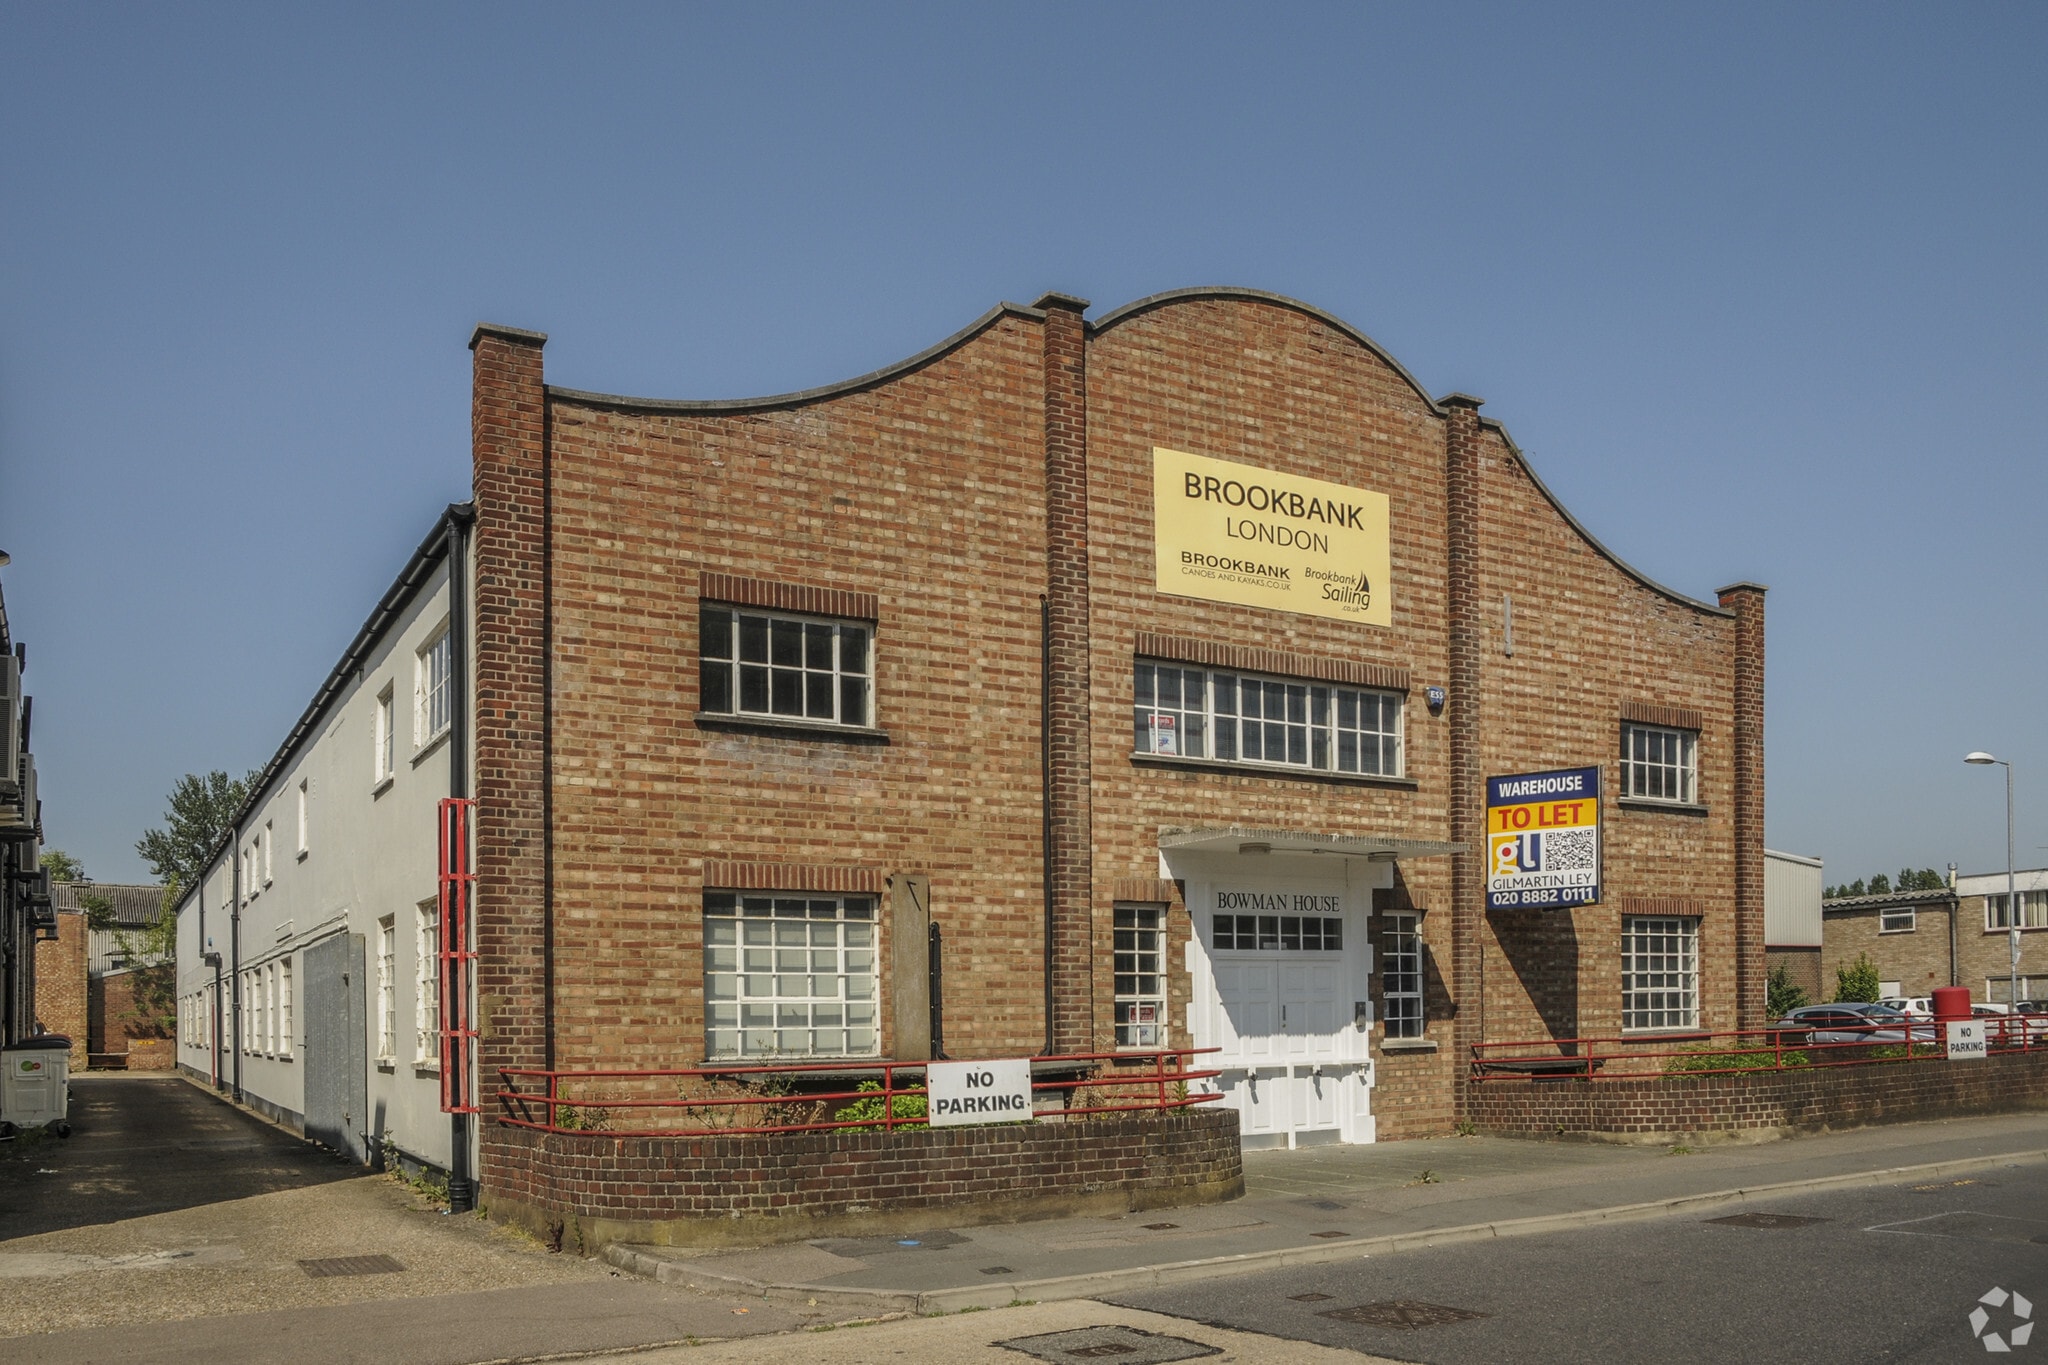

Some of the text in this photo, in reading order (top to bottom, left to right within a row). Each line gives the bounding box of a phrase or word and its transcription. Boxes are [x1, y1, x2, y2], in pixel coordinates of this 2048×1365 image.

[1184, 472, 1364, 530] BROOKBANK
[1227, 517, 1328, 554] LONDON
[1181, 551, 1290, 580] BROOKBANK
[1305, 567, 1357, 585] Brookbank
[1181, 567, 1291, 591] CANOES AND KAYAKS.CO.UK
[1322, 583, 1370, 610] Sailing
[1499, 776, 1583, 797] WAREHOUSE
[1498, 803, 1583, 829] TO LET
[1493, 873, 1592, 890] GILMARTIN LEY
[1218, 892, 1340, 912] BOWMAN HOUSE
[1493, 887, 1593, 905] 020 8882 0111
[1960, 1027, 1971, 1038] NO
[1950, 1041, 1983, 1053] PARKING
[966, 1072, 994, 1088] NO
[937, 1094, 1025, 1115] PARKING
